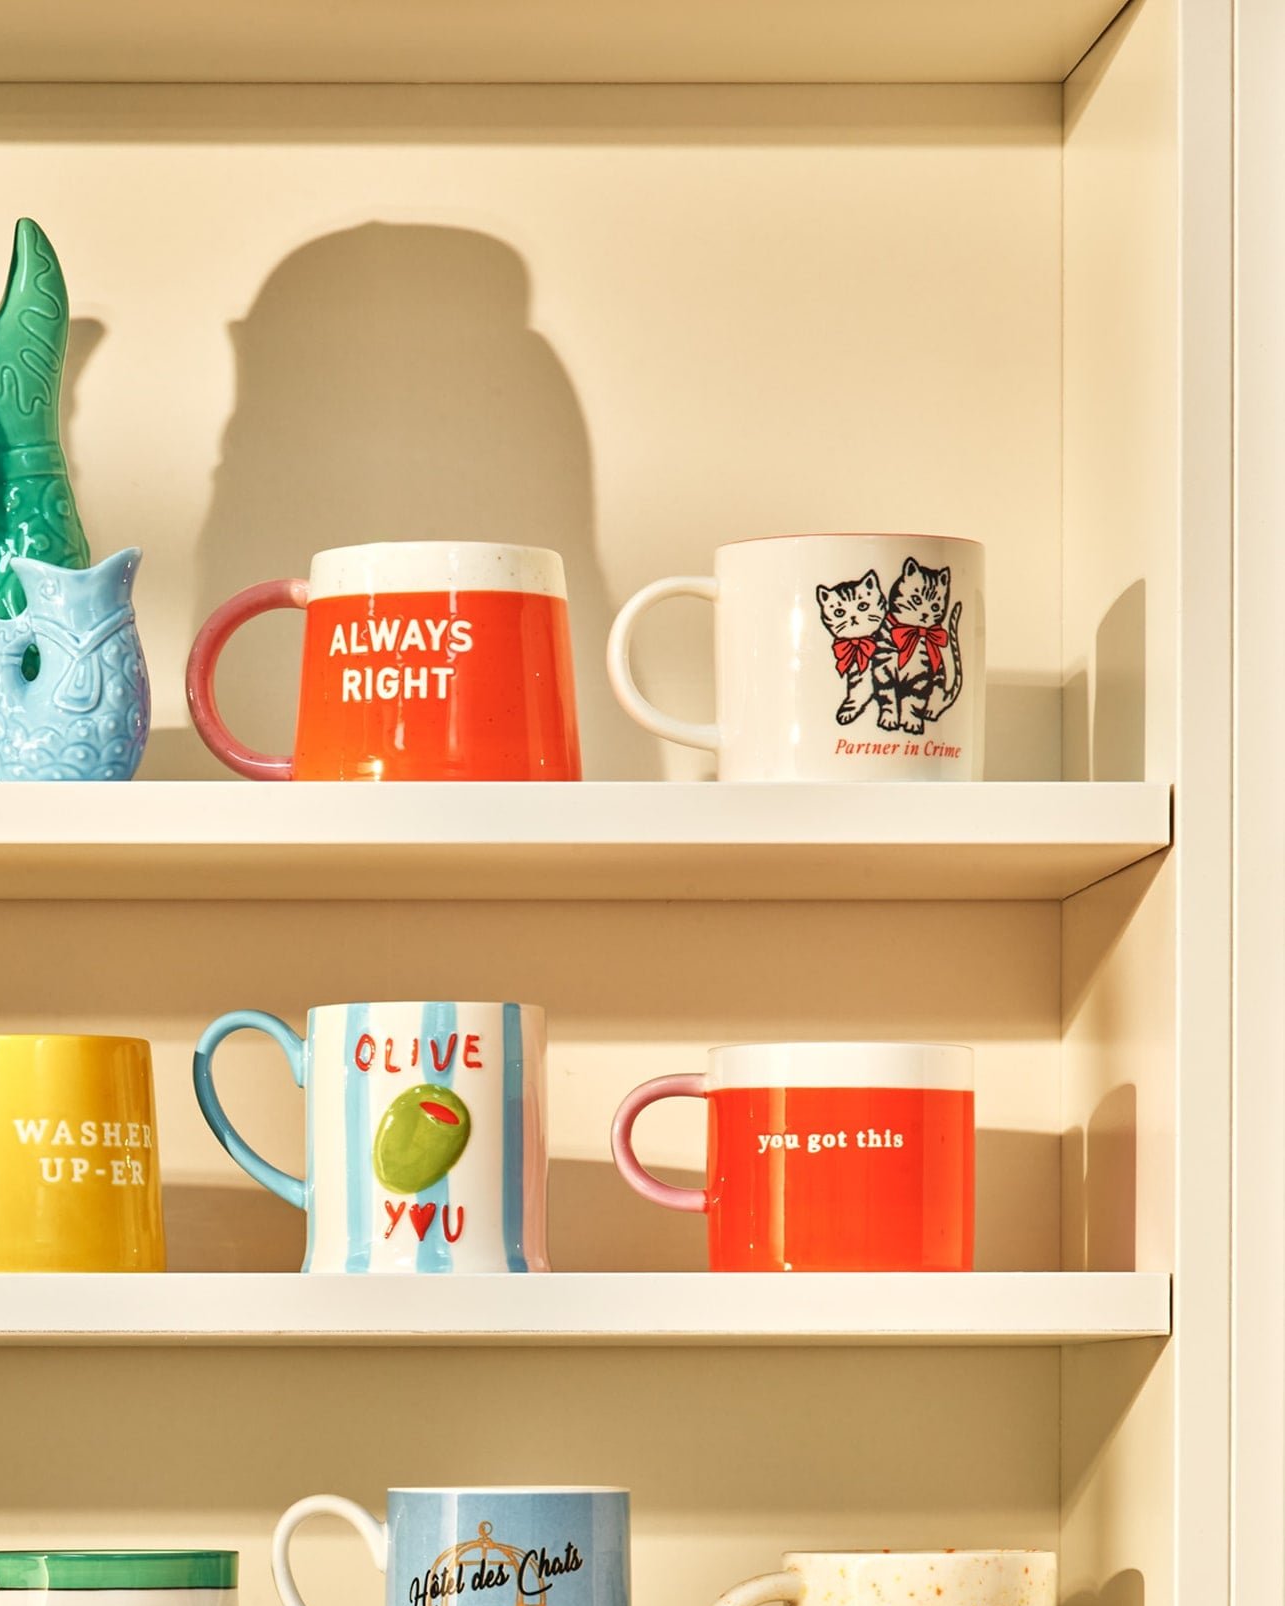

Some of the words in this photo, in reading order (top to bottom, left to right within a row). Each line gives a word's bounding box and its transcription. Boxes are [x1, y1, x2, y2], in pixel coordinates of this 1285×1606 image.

[329, 617, 474, 657] ALWAYS
[342, 666, 455, 702] RIGHT
[835, 739, 900, 755] Partner
[904, 740, 919, 755] in
[923, 740, 962, 758] Crime
[354, 1033, 483, 1073] OLIVE
[13, 1119, 152, 1149] WASHER
[757, 1134, 801, 1154] you
[807, 1131, 848, 1153] got
[856, 1129, 904, 1148] this
[39, 1157, 145, 1185] UP-ER
[471, 1558, 510, 1591] des
[517, 1541, 583, 1596] Chats
